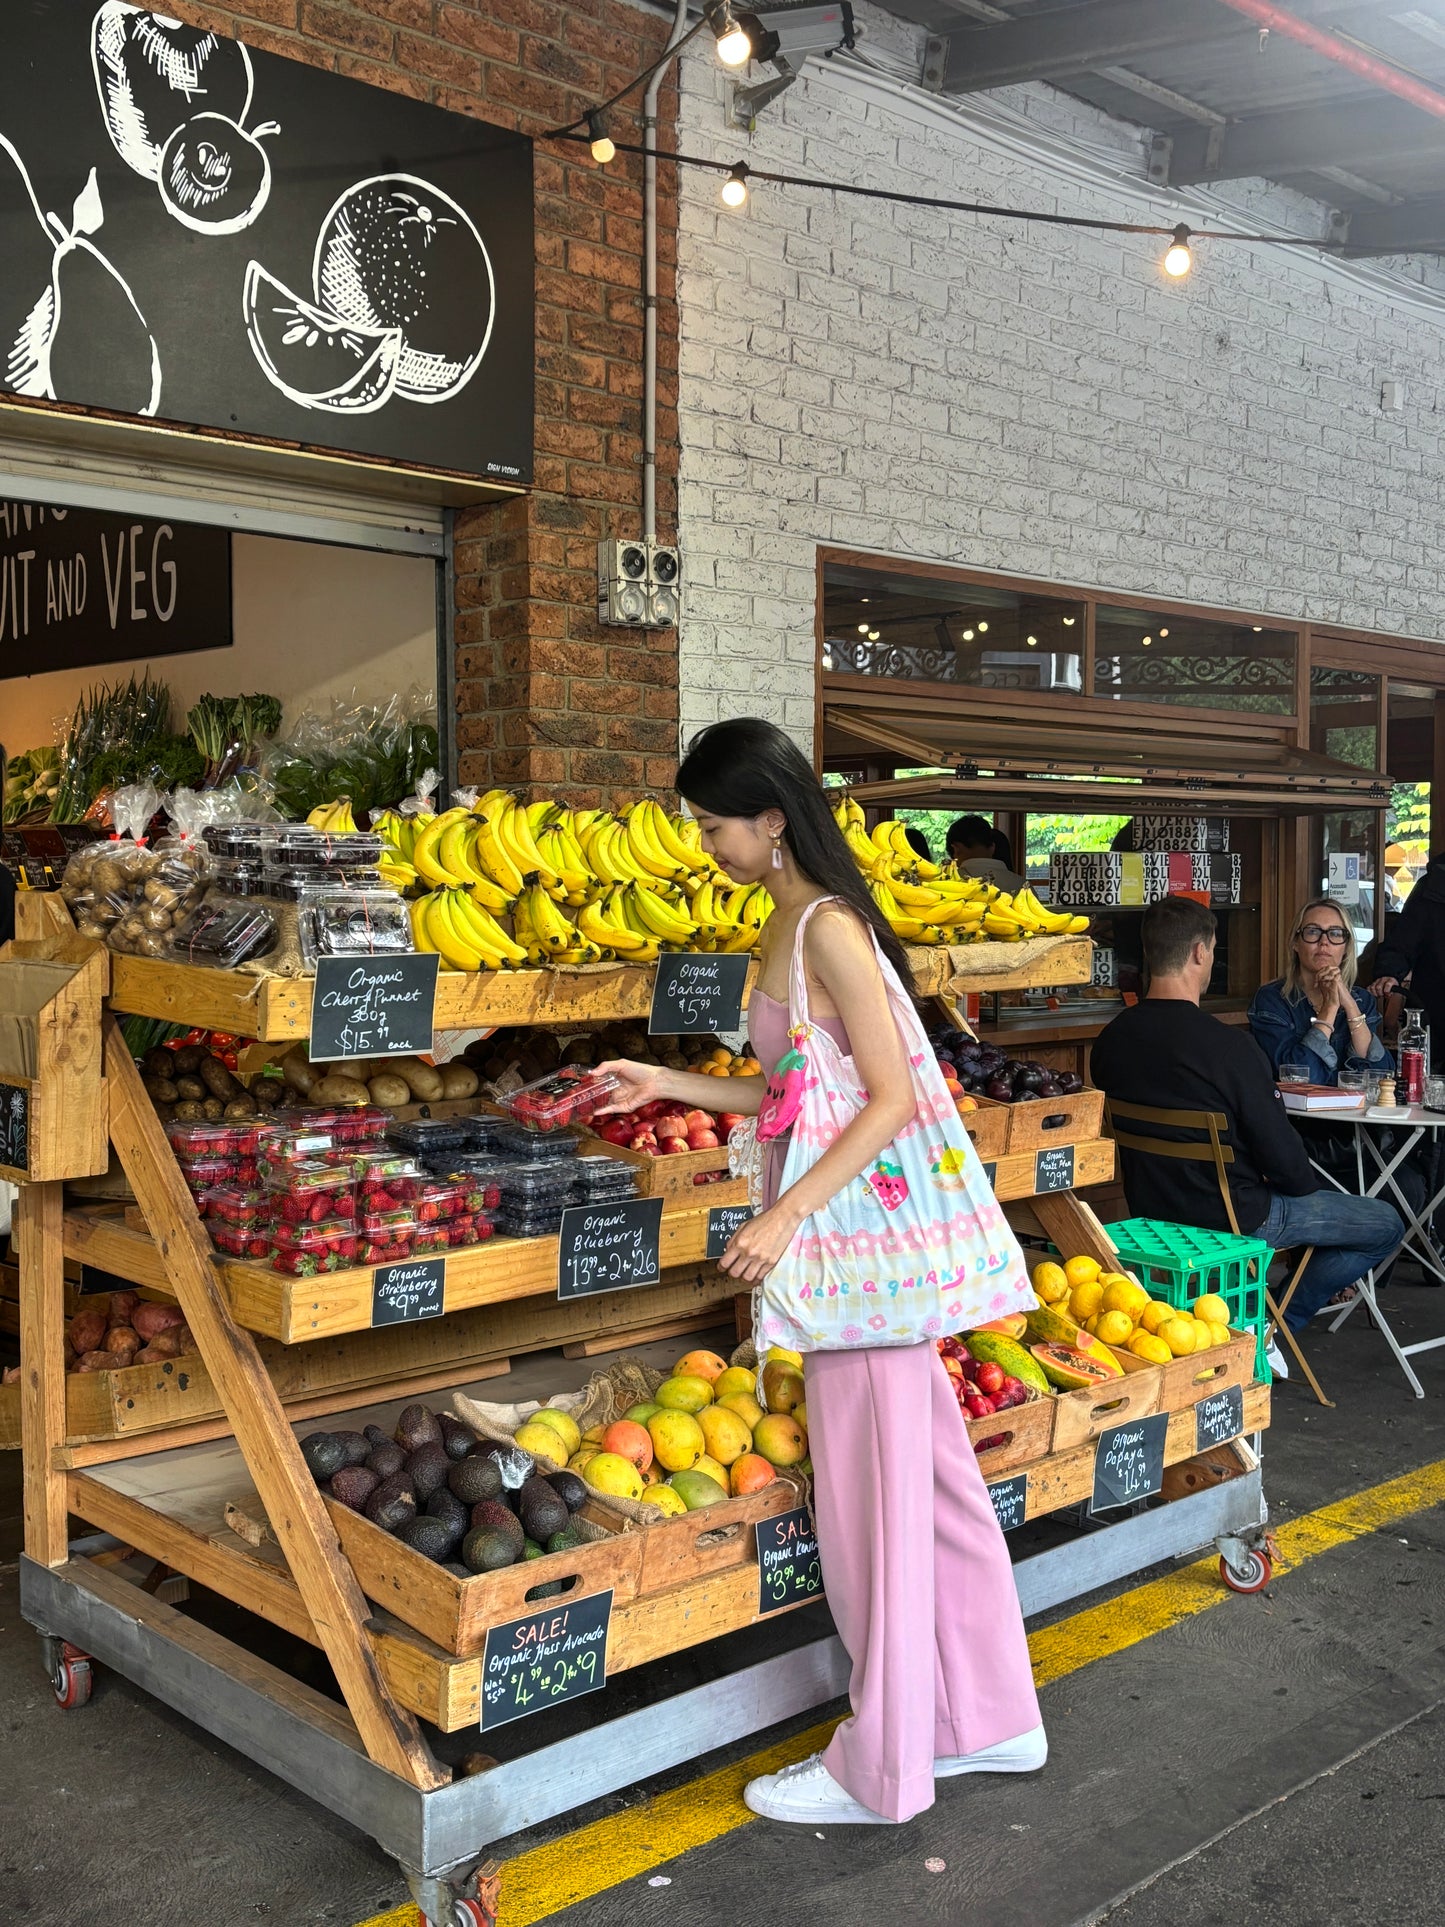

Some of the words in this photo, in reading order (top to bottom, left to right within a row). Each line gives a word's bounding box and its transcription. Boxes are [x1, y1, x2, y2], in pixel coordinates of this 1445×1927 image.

[47, 553, 87, 625] AND
[101, 525, 177, 630] VEG
[348, 967, 404, 994] Organic
[680, 962, 719, 984] Organic
[374, 988, 422, 1007] Punnet
[667, 980, 721, 997] Banana
[321, 990, 371, 1012] Cherry
[388, 1040, 412, 1049] each
[583, 1209, 626, 1235] Organic
[721, 1208, 746, 1222] Organic
[573, 1227, 643, 1252] Blueberry
[388, 1266, 428, 1287] Organic
[609, 1253, 621, 1280] 2
[378, 1279, 438, 1297] Strawberry
[799, 1281, 850, 1299] have
[862, 1280, 878, 1293] a
[419, 1302, 439, 1317] punnet
[1112, 1428, 1144, 1451] Organic
[990, 1481, 1013, 1501] Organic
[763, 1543, 793, 1571] Organic
[807, 1561, 820, 1591] 2
[512, 1611, 569, 1649] SALE!
[489, 1647, 532, 1676] Organic
[529, 1641, 561, 1666] Hass
[562, 1625, 605, 1652] Avocado
[551, 1660, 567, 1695] 2
